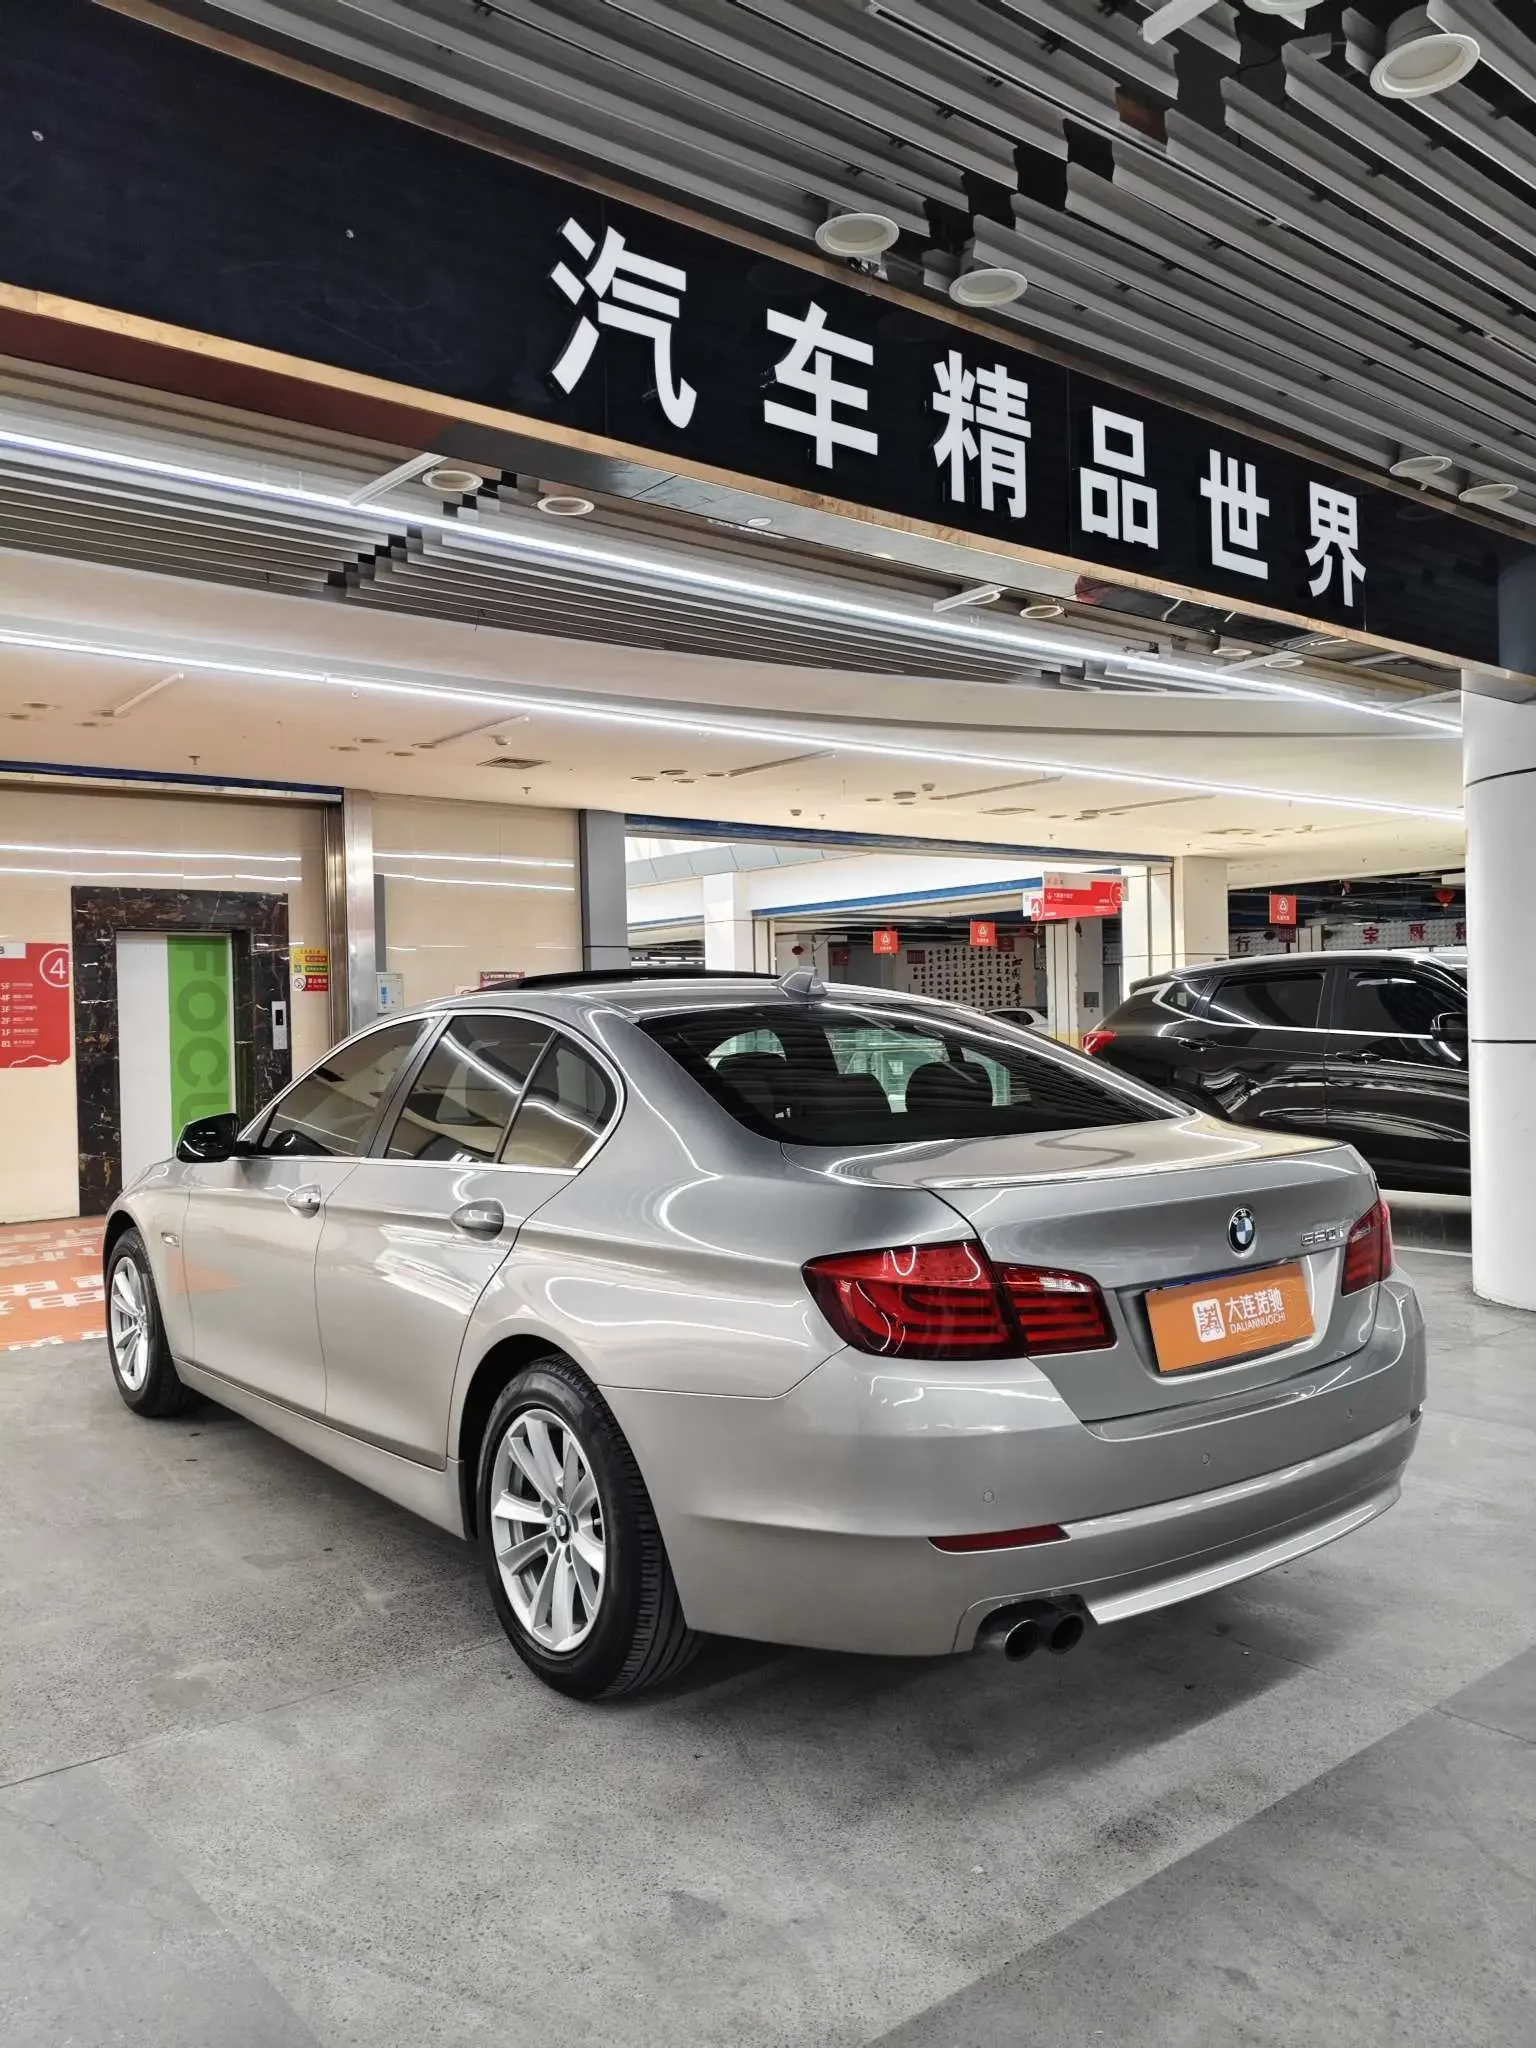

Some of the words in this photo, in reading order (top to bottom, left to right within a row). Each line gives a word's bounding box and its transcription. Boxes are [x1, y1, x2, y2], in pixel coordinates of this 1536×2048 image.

[549, 216, 1367, 607] 汽车精品世界
[48, 957, 67, 980] 4
[1301, 1225, 1345, 1247] 520i
